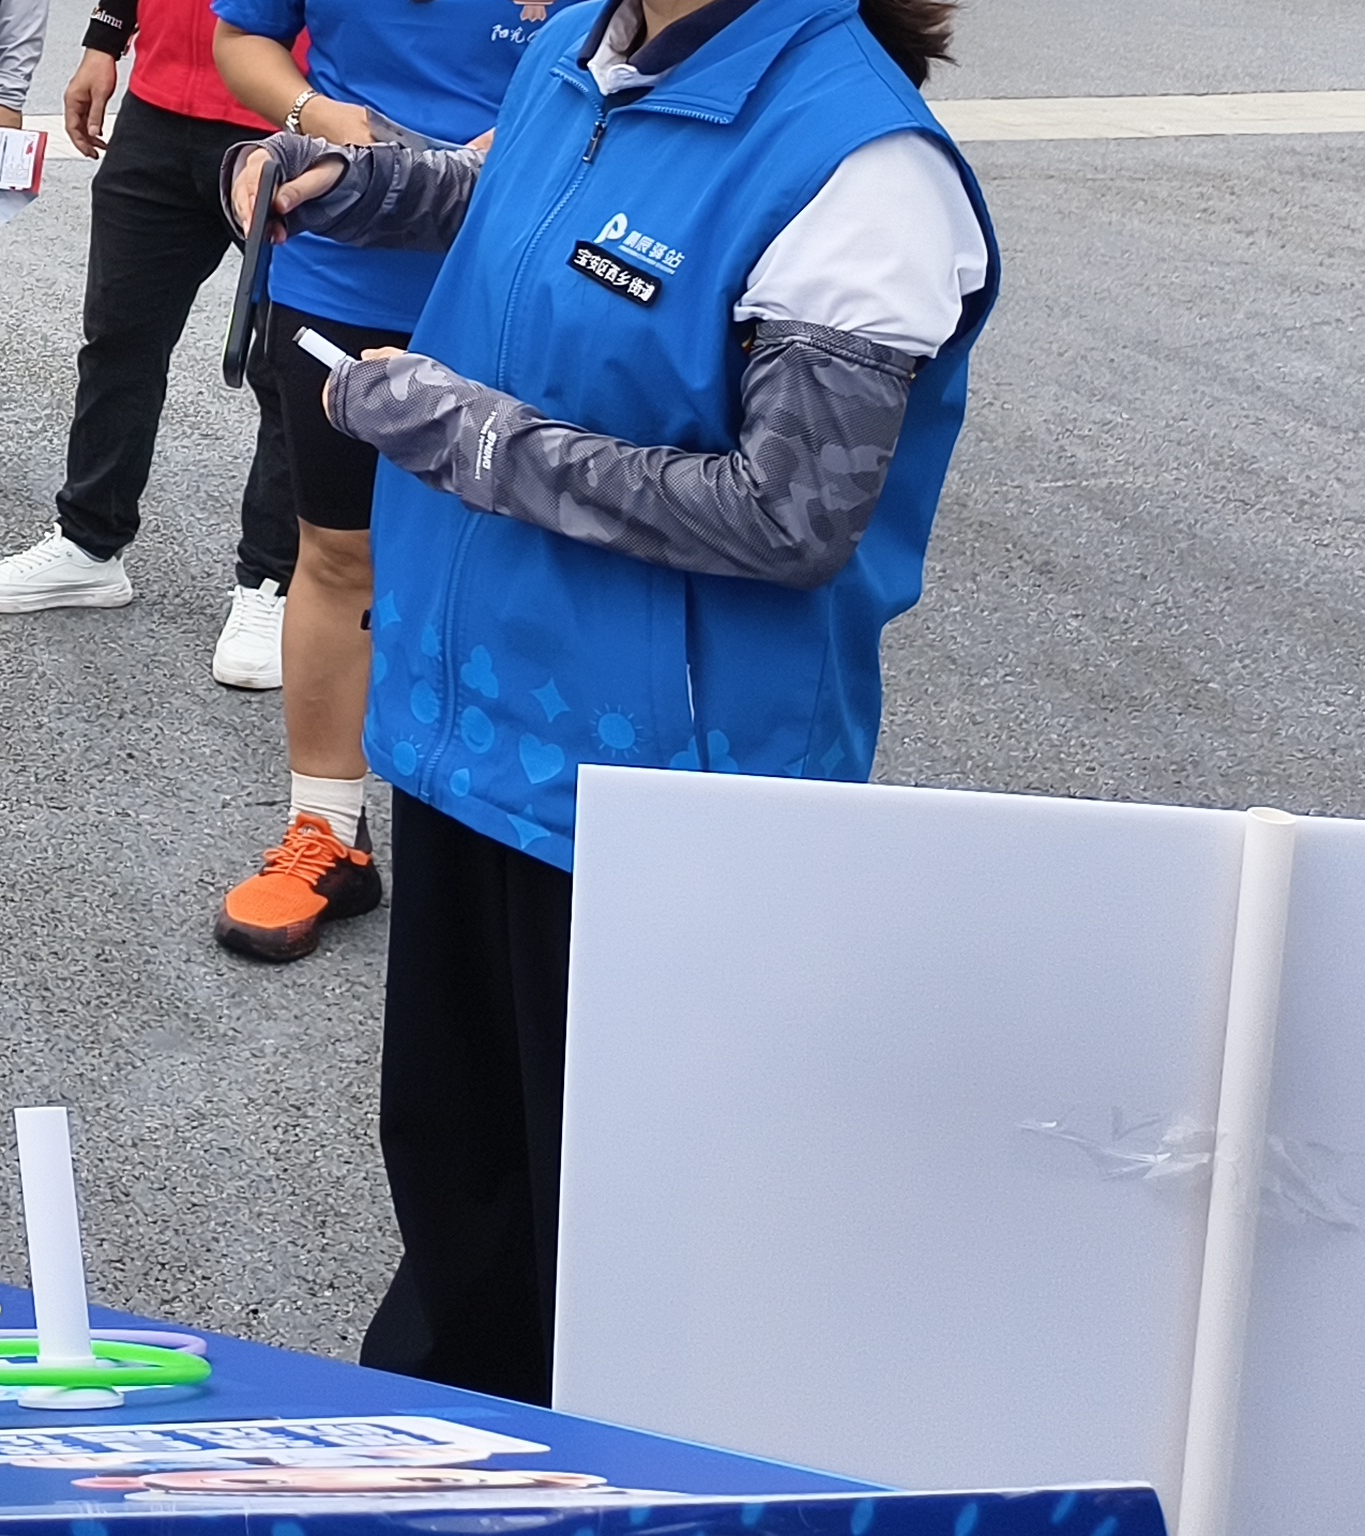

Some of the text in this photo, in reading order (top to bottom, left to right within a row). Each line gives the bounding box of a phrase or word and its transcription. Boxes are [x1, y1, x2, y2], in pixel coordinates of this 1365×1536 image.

[573, 248, 656, 302] 宝安区西乡街道
